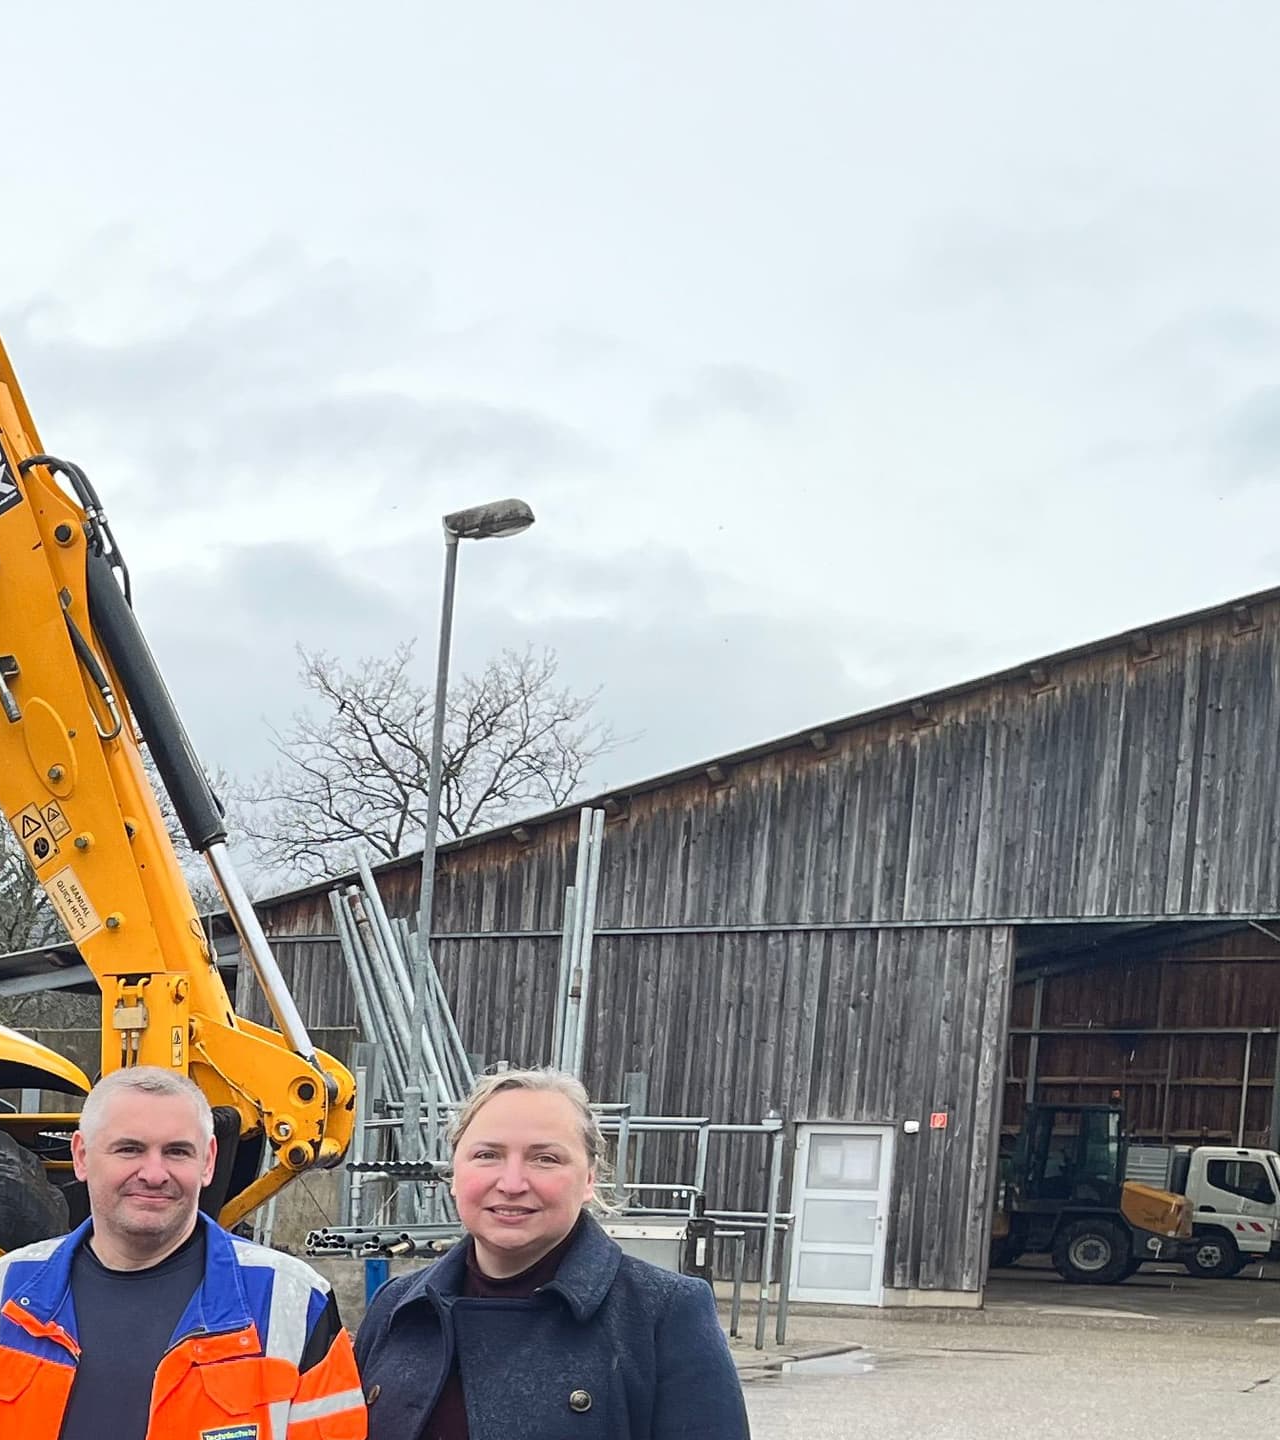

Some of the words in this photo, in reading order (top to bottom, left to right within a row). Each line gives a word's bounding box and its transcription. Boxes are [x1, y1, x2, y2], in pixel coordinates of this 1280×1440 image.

[56, 880, 73, 905] QUICK
[70, 902, 87, 930] HITCH
[70, 884, 91, 917] MANUAL
